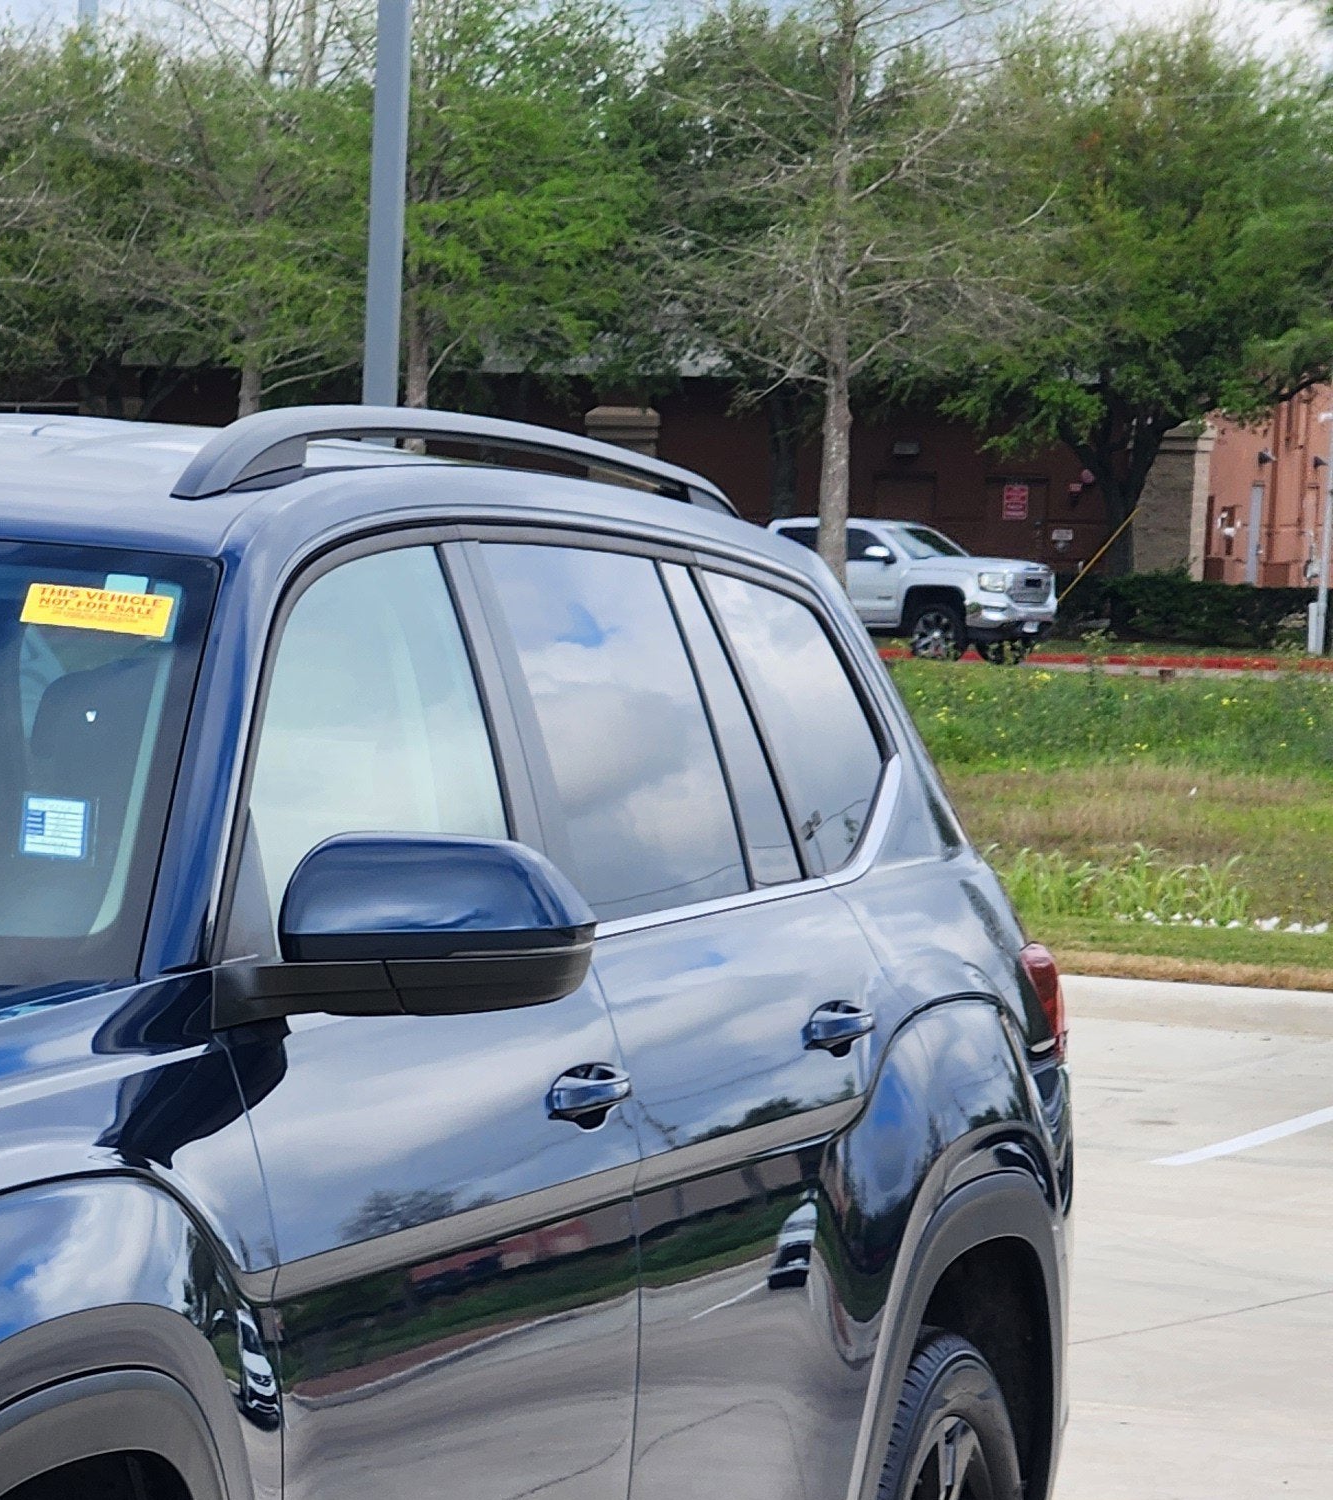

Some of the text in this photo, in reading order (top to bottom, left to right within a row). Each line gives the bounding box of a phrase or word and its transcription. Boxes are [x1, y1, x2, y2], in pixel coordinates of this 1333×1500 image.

[38, 597, 70, 607] NOT
[76, 600, 109, 611] FOR
[115, 604, 156, 616] SALE
[39, 587, 163, 608] THIS VEHICLE
